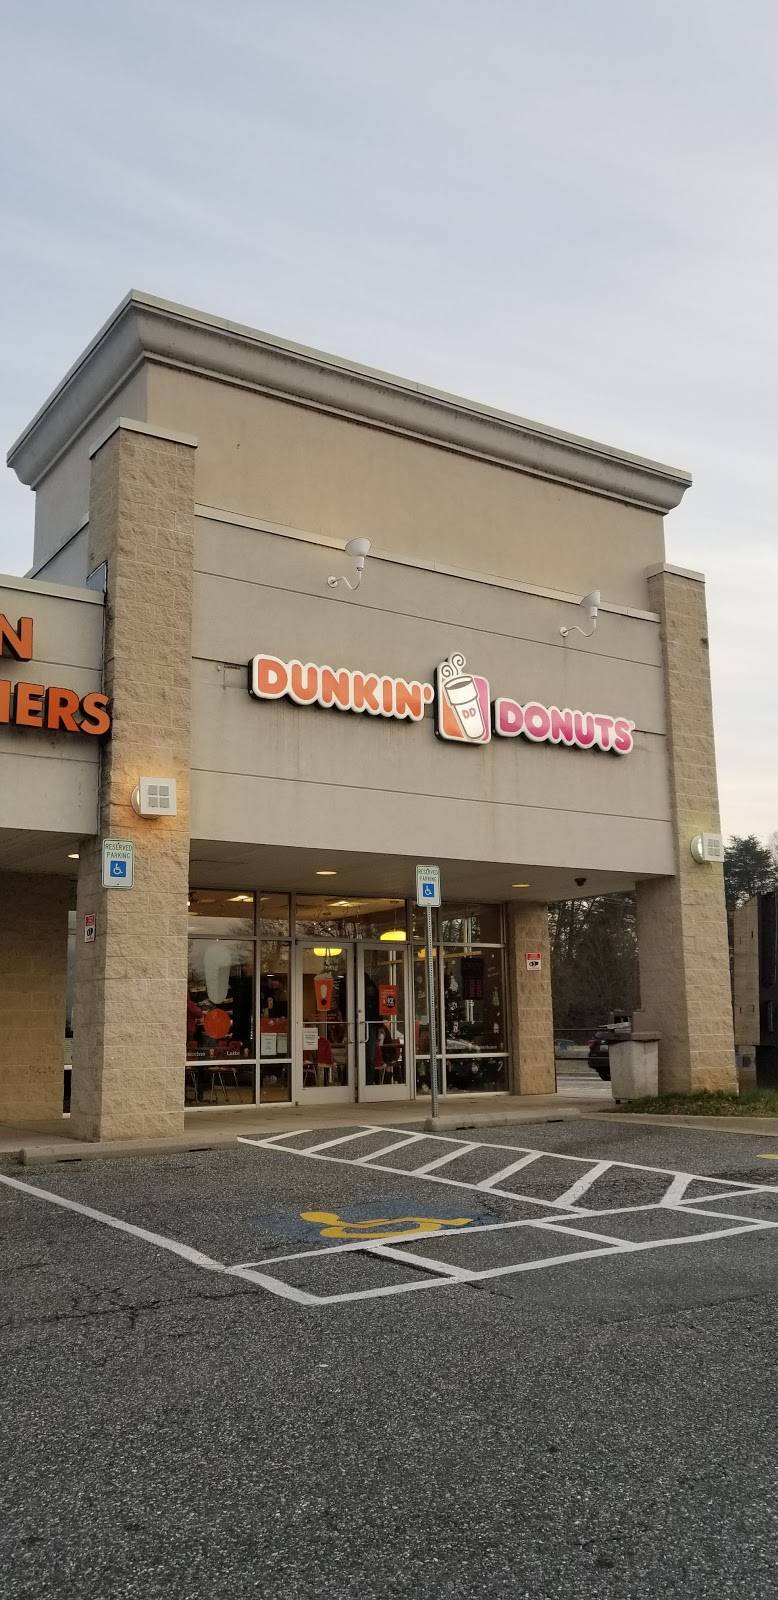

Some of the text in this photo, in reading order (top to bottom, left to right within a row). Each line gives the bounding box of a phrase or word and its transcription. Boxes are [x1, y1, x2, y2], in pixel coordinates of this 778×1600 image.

[254, 656, 633, 752] DUNKIN' DONUTS
[462, 707, 476, 719] DD
[105, 843, 132, 852] RESERVED
